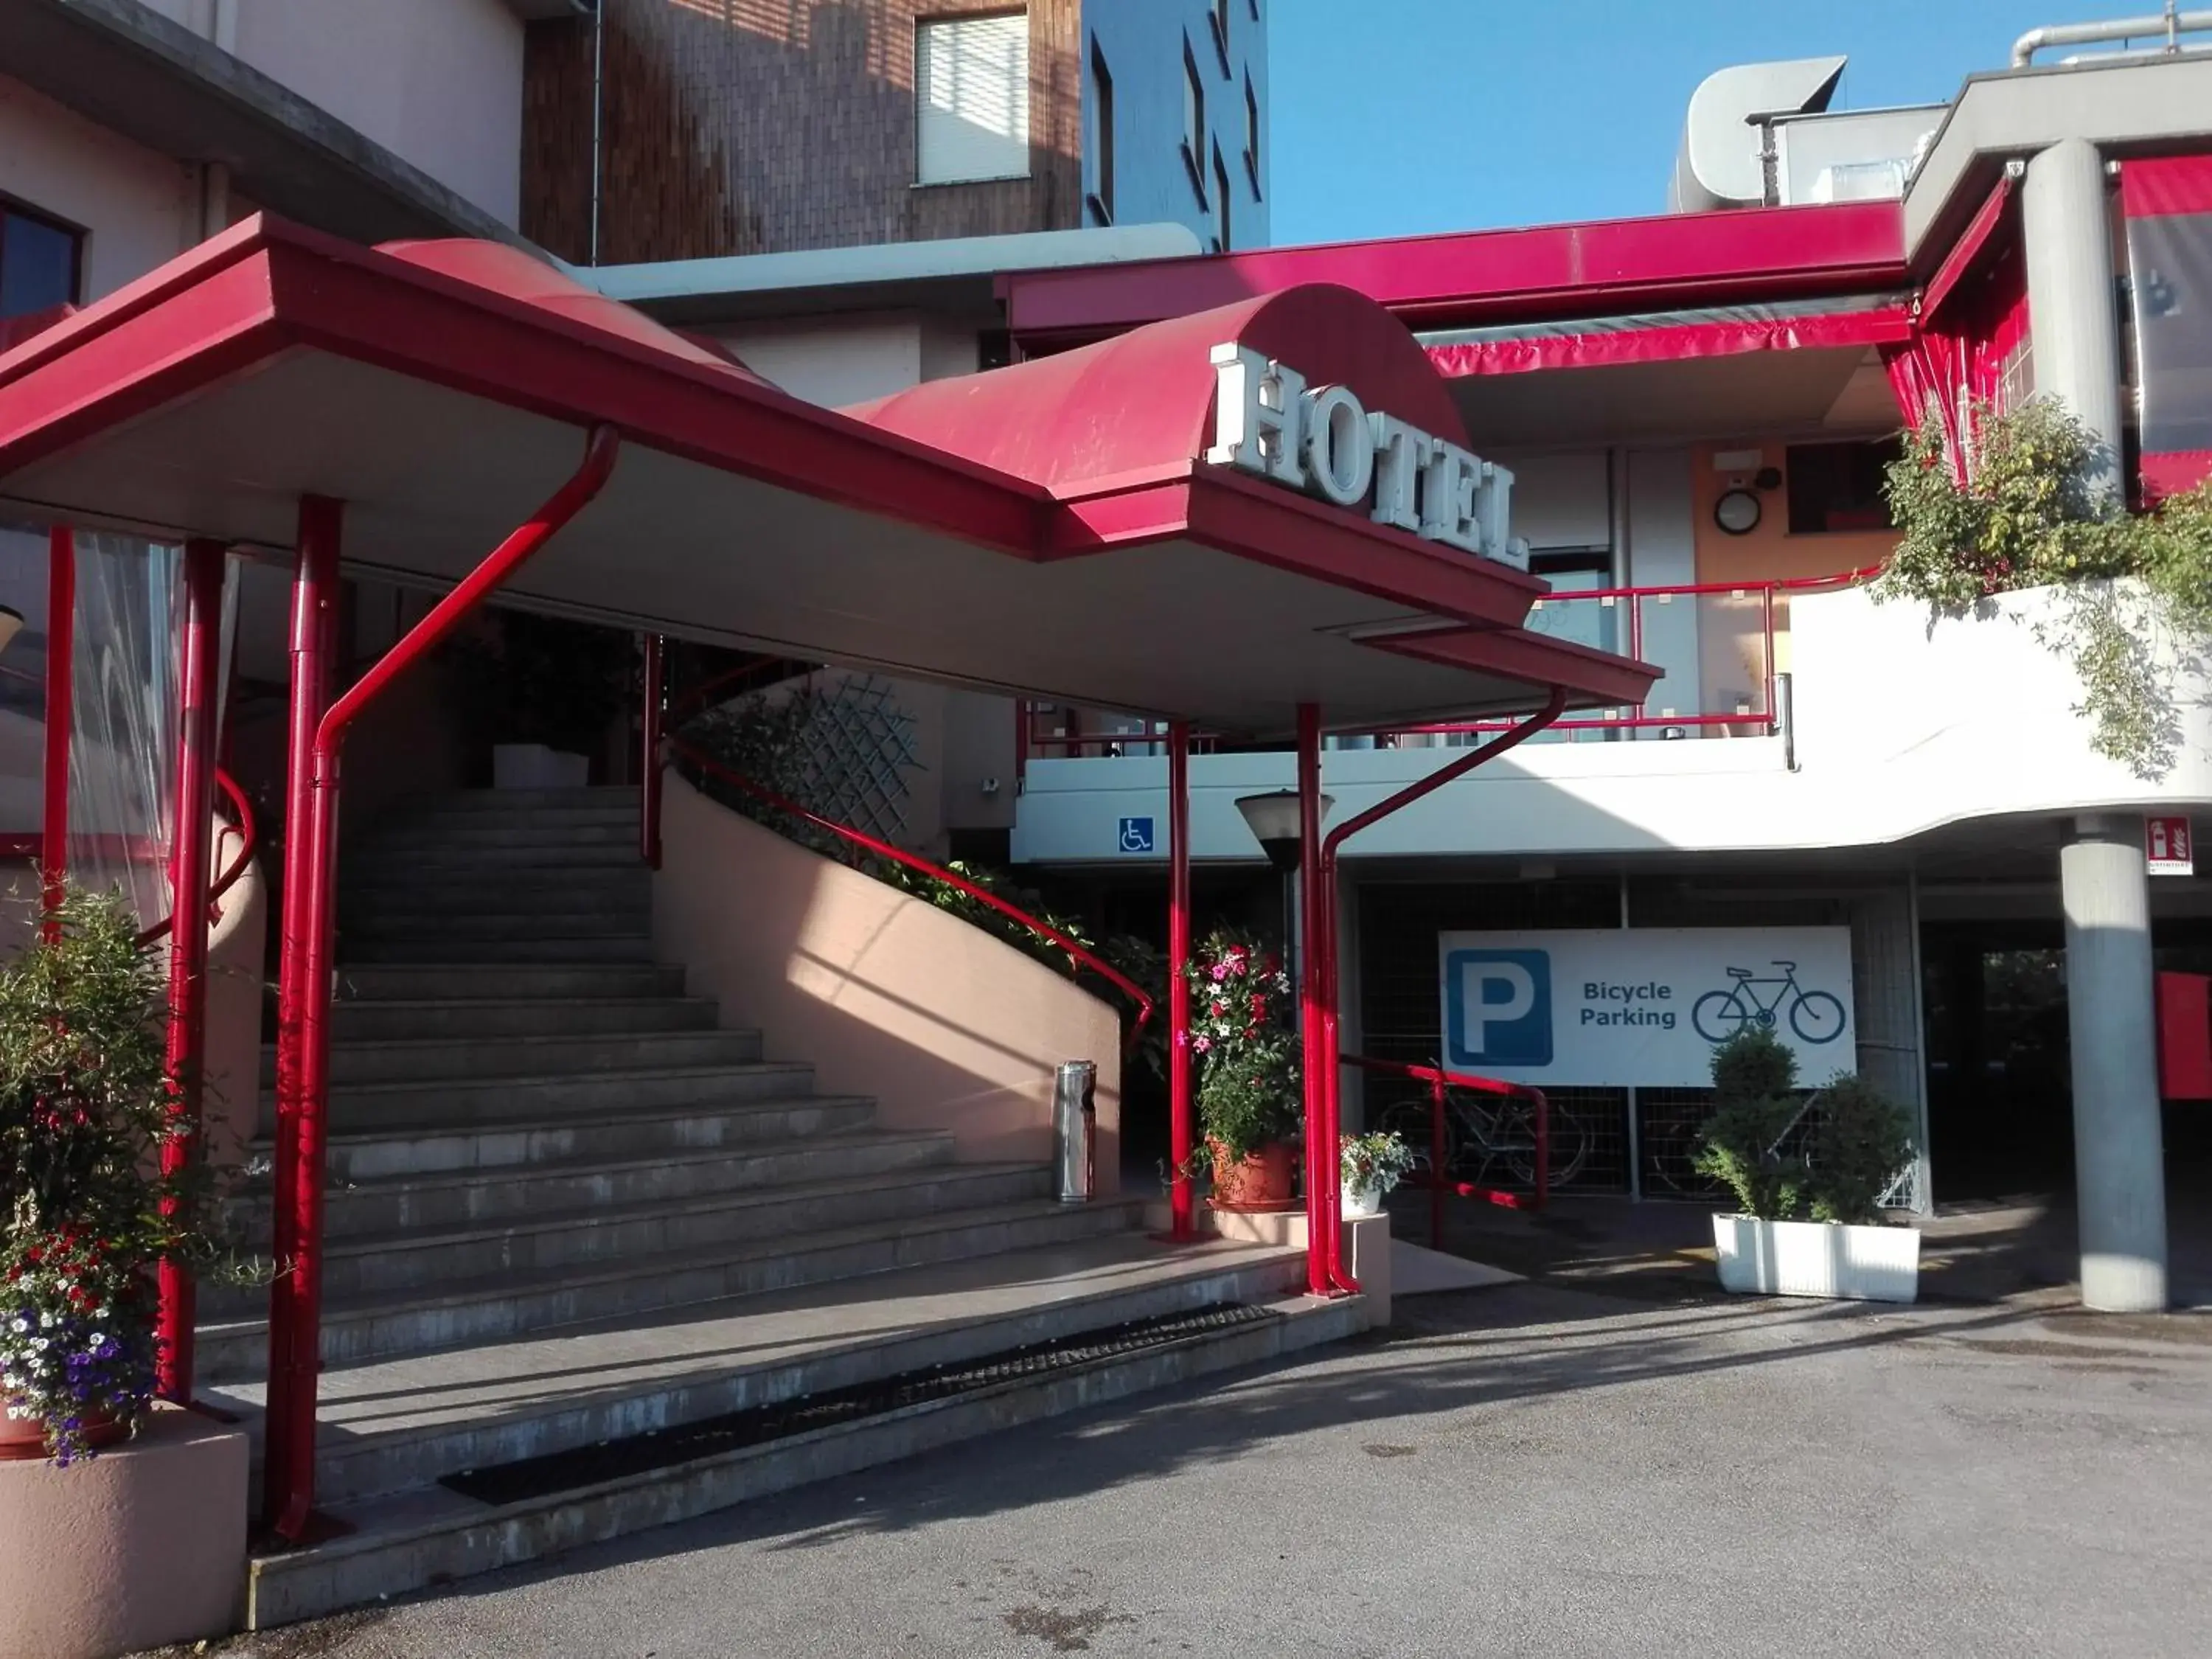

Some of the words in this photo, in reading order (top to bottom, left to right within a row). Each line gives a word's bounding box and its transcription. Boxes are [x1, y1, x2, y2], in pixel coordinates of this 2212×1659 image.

[1208, 339, 1529, 574] HOTEL
[1461, 961, 1535, 1054] P
[1580, 1008, 1677, 1029] Parking
[1583, 981, 1672, 1004] Bicycle
